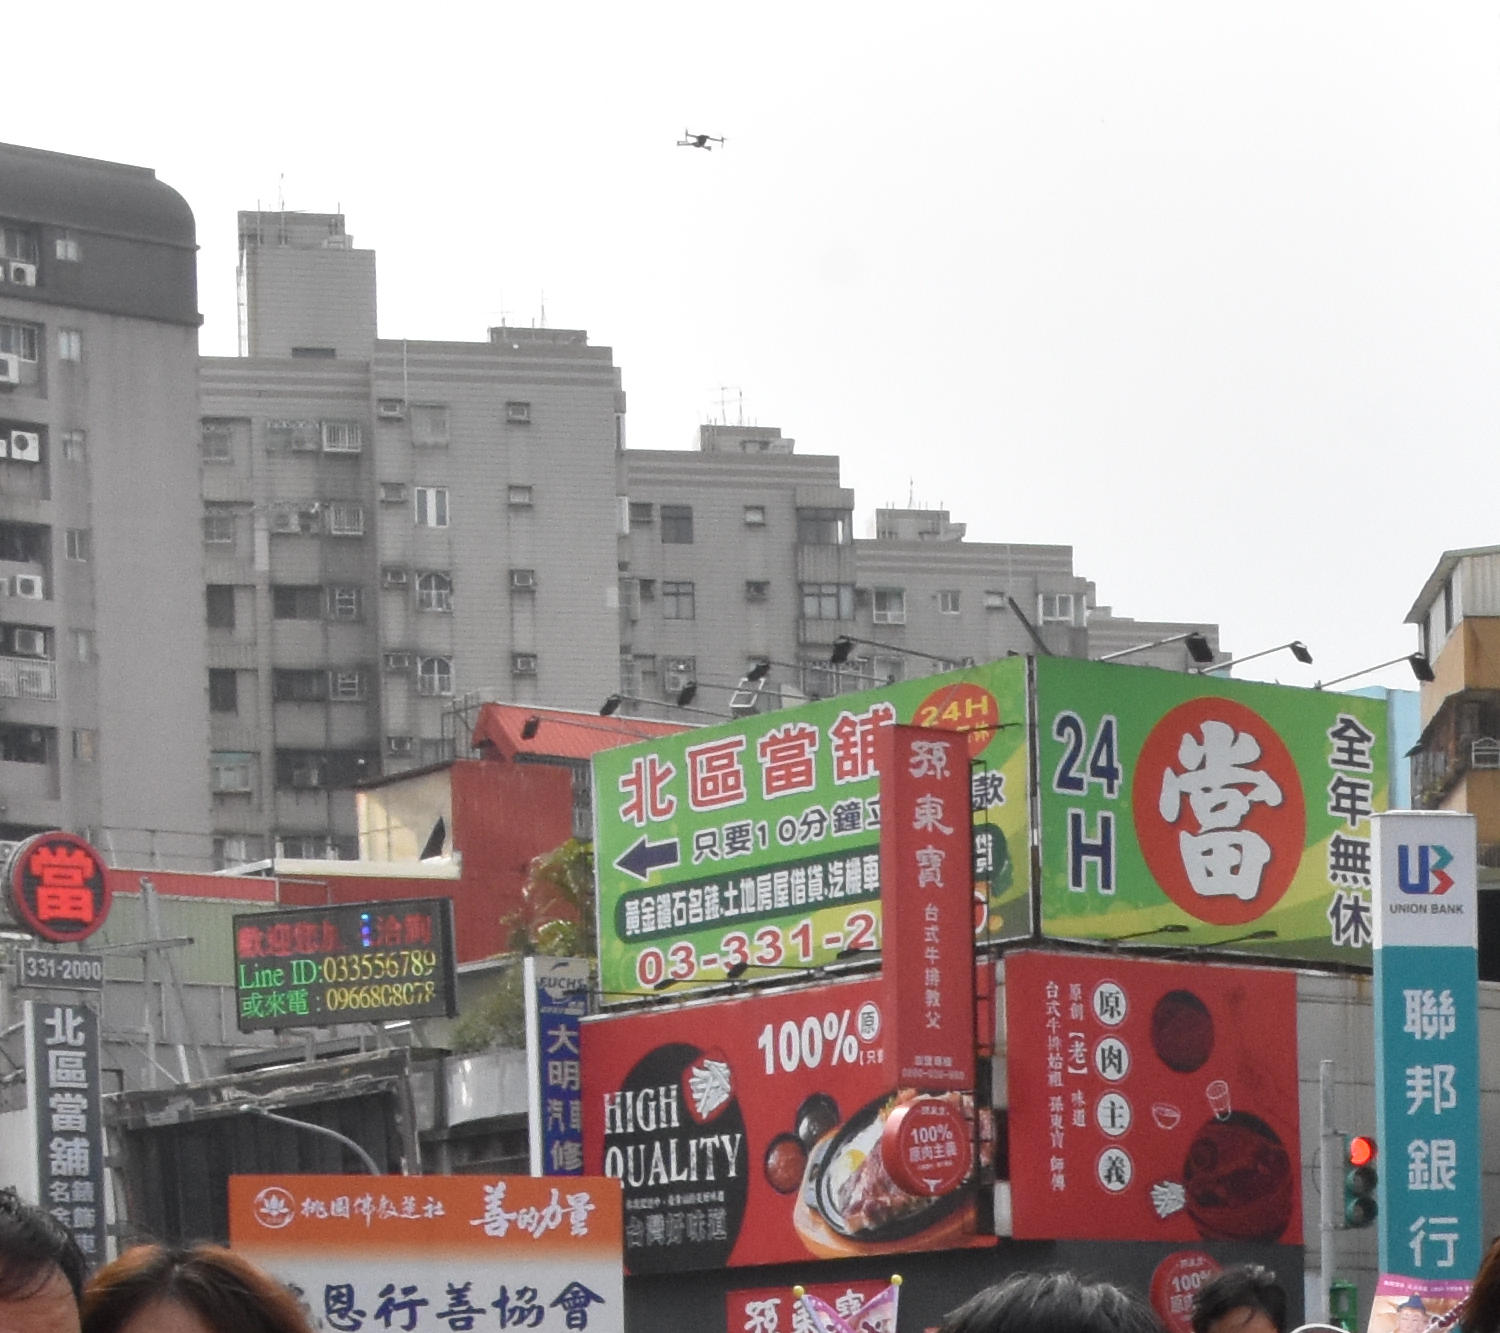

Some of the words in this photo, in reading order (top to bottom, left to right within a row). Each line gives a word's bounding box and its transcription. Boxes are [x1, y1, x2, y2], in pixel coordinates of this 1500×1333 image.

[618, 700, 897, 828] 北區當舖
[1052, 709, 1123, 800] 24
[1158, 719, 1284, 901] 當
[1326, 712, 1374, 948] 全年無休
[29, 845, 95, 923] 當
[1066, 808, 1117, 895] H
[1389, 903, 1428, 915] UNION
[1431, 903, 1464, 915] BANK
[26, 957, 101, 981] 331-2000
[238, 962, 285, 990] Line
[757, 1009, 859, 1075] 100%
[44, 1006, 91, 1178] 北區當舖
[603, 1083, 679, 1135] HIGH
[1099, 988, 1127, 1187] 原肉主義
[604, 1133, 742, 1189] QUALITY
[910, 1123, 955, 1144] 100%
[1403, 988, 1459, 1269] 聯邦銀行
[469, 1180, 596, 1240] 善的力量
